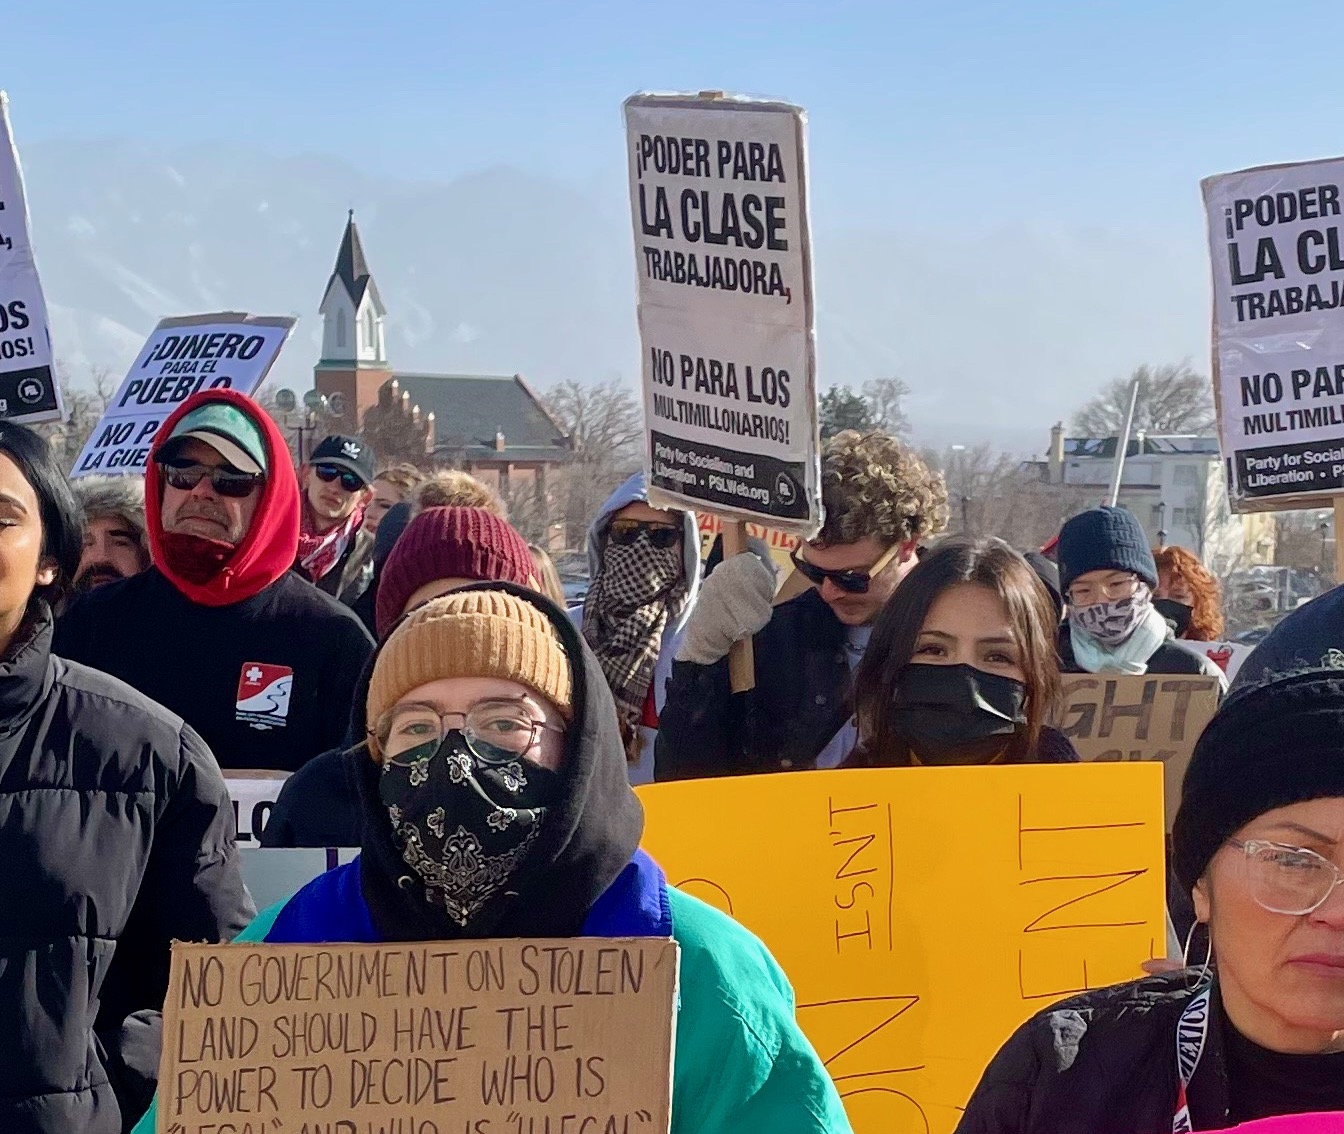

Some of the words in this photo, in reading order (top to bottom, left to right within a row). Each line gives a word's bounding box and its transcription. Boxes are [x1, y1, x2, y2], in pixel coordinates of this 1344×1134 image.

[636, 133, 710, 179] ¡PODER
[717, 140, 786, 183] PARA
[638, 183, 674, 240] LA
[681, 189, 788, 251] CLASE
[1225, 184, 1342, 239] ¡PODER
[643, 246, 791, 304] TRABAJADORA,
[1228, 237, 1285, 286] LA
[142, 333, 265, 369] ¡DINERO
[160, 360, 198, 374] PARA
[200, 360, 218, 373] EL
[651, 348, 674, 387] NO
[681, 355, 740, 399] PARA
[747, 365, 790, 408] LOS
[1240, 372, 1283, 407] NO
[94, 422, 135, 448] NO
[654, 393, 790, 444] MULTIMILLONARIOS!
[79, 452, 106, 471] LA
[689, 452, 733, 474] Socialism
[734, 464, 754, 478] and
[1246, 457, 1281, 472] Party
[1283, 453, 1301, 466] for
[1248, 470, 1314, 488] Liberation
[708, 475, 769, 504] PSLWeb.org
[180, 955, 224, 1009] NO
[239, 951, 460, 1005] GOVERNMENT
[468, 947, 506, 992] ON
[518, 944, 645, 996] STOLEN
[178, 1016, 258, 1063] LAND
[273, 1011, 376, 1059] SHOULD
[393, 1006, 477, 1052] HAVE
[498, 1005, 574, 1050] THE
[176, 1066, 279, 1116] POWER
[292, 1067, 332, 1108] TO
[351, 1058, 457, 1107] DECIDE
[482, 1057, 554, 1107] WHO
[576, 1057, 605, 1098] IS
